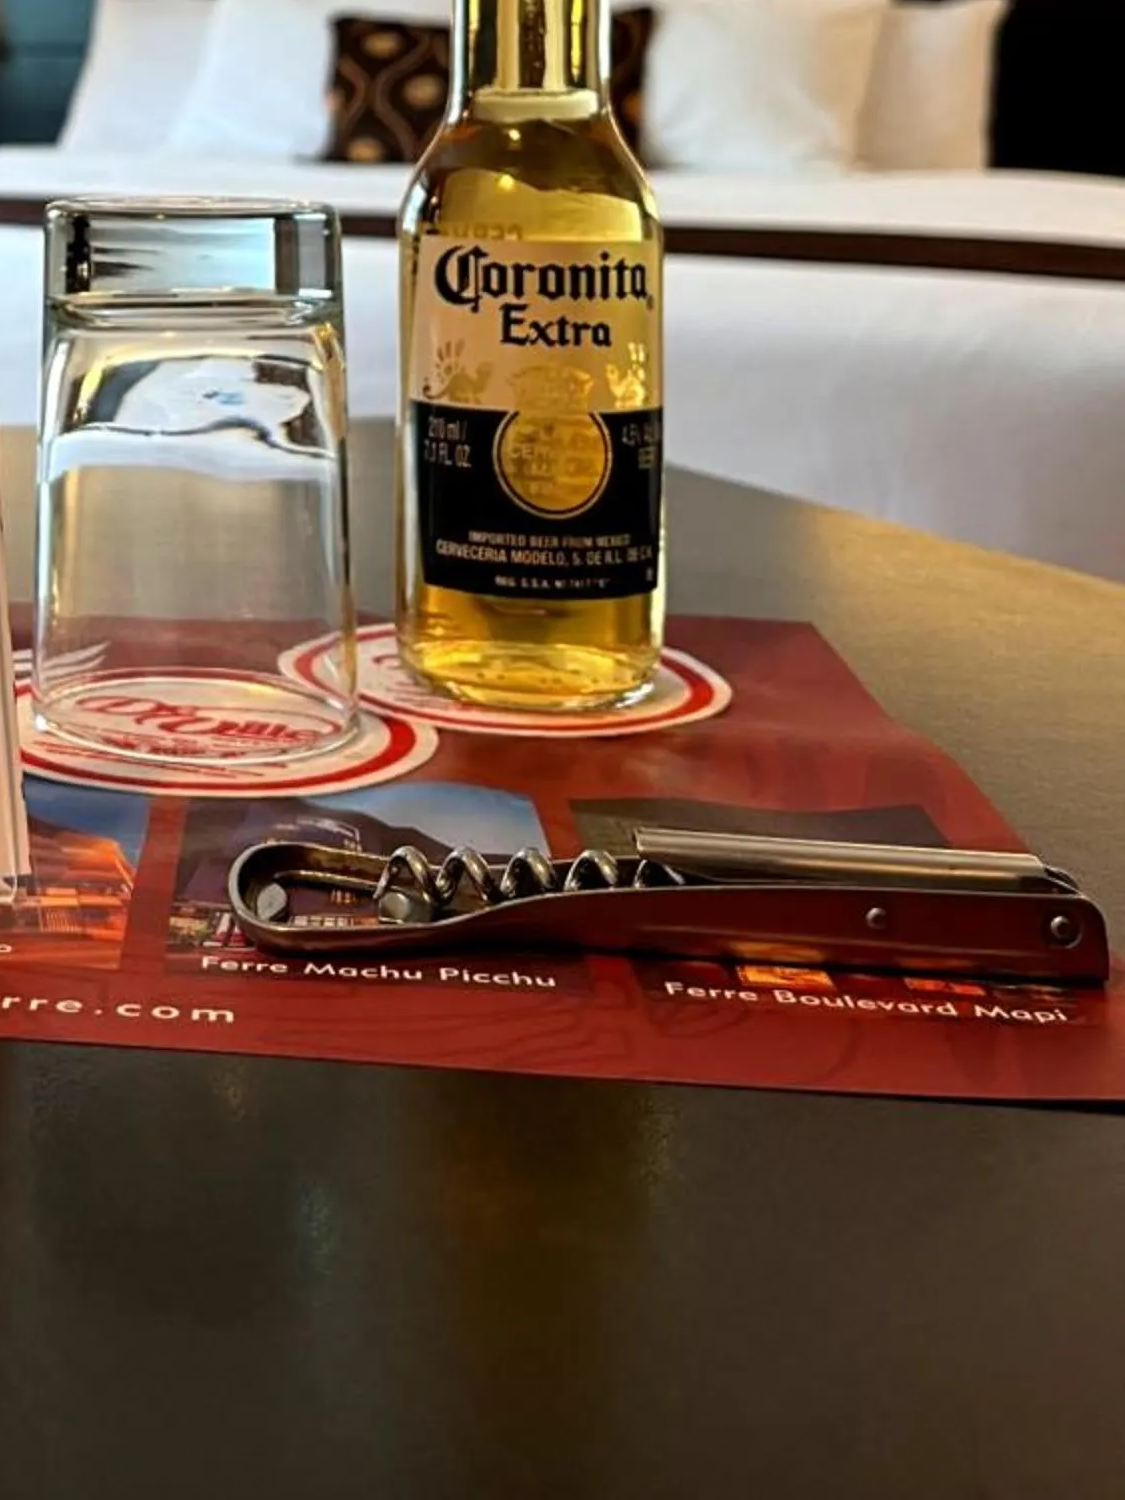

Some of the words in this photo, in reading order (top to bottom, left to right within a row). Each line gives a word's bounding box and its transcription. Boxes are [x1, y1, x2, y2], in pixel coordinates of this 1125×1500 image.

[434, 246, 647, 313] Coronita
[499, 303, 612, 347] Extra
[201, 956, 288, 974] Ferre
[304, 962, 422, 980] Machu
[439, 967, 557, 988] Picchu
[664, 981, 759, 1001] Ferre
[774, 989, 958, 1017] Boulevard
[974, 1004, 1068, 1024] Mapi
